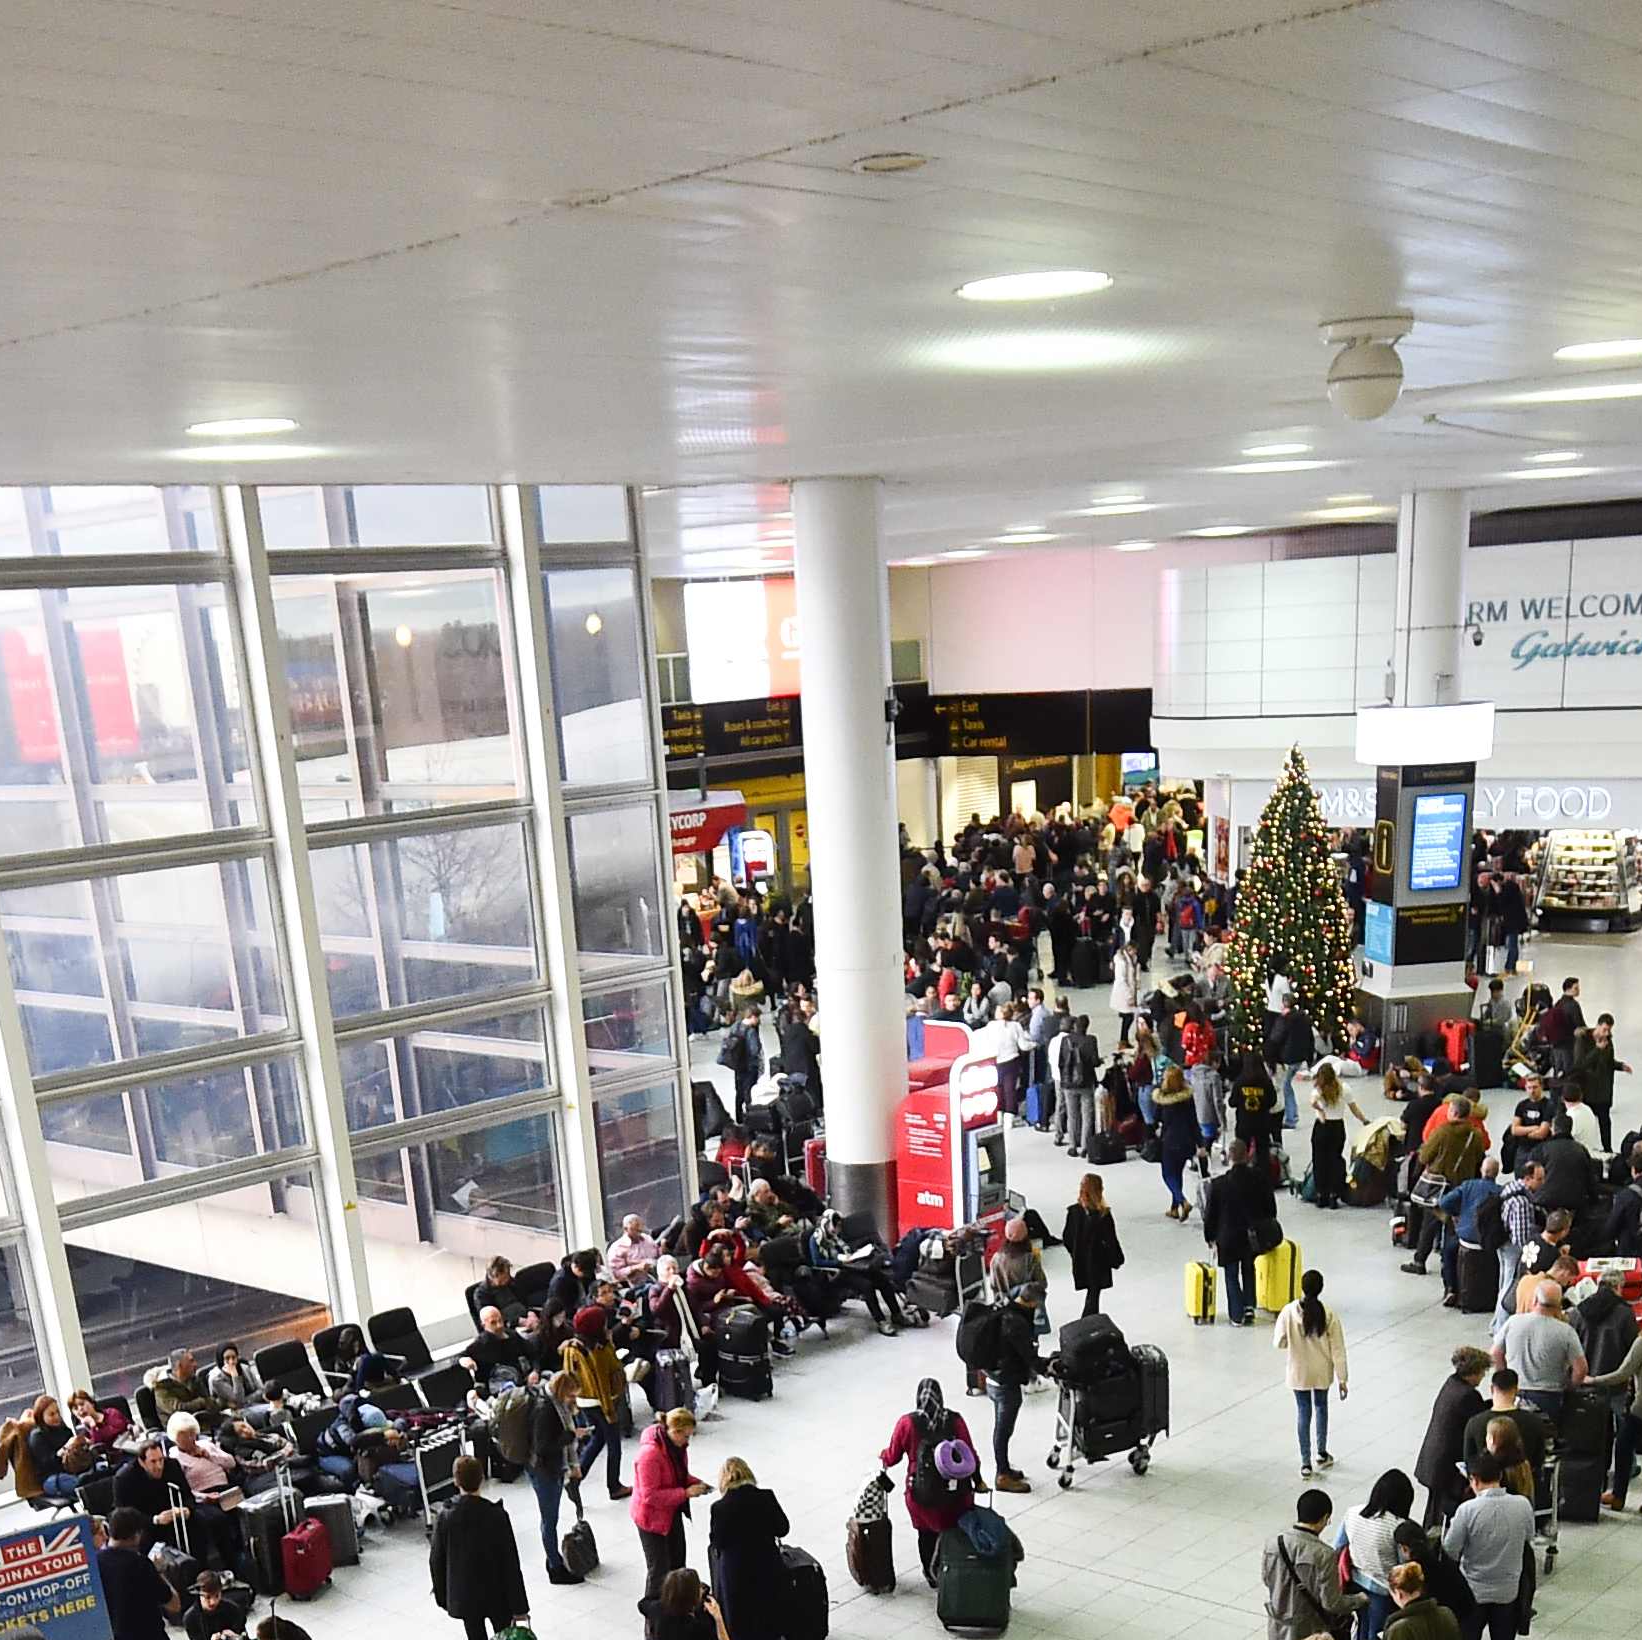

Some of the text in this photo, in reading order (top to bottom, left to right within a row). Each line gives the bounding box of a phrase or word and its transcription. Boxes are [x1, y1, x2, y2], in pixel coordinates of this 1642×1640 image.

[672, 709, 692, 721] Taxis
[962, 701, 979, 713] Exit
[963, 719, 985, 731] Taxis
[963, 735, 1007, 748] Car rental
[1515, 786, 1613, 821] FOOD
[669, 812, 707, 831] YCORP
[917, 1190, 944, 1209] atm
[6, 1542, 37, 1559] THE
[43, 1551, 84, 1572] TOUR
[31, 1573, 91, 1597] HOP-OFF
[53, 1595, 97, 1618] HERE
